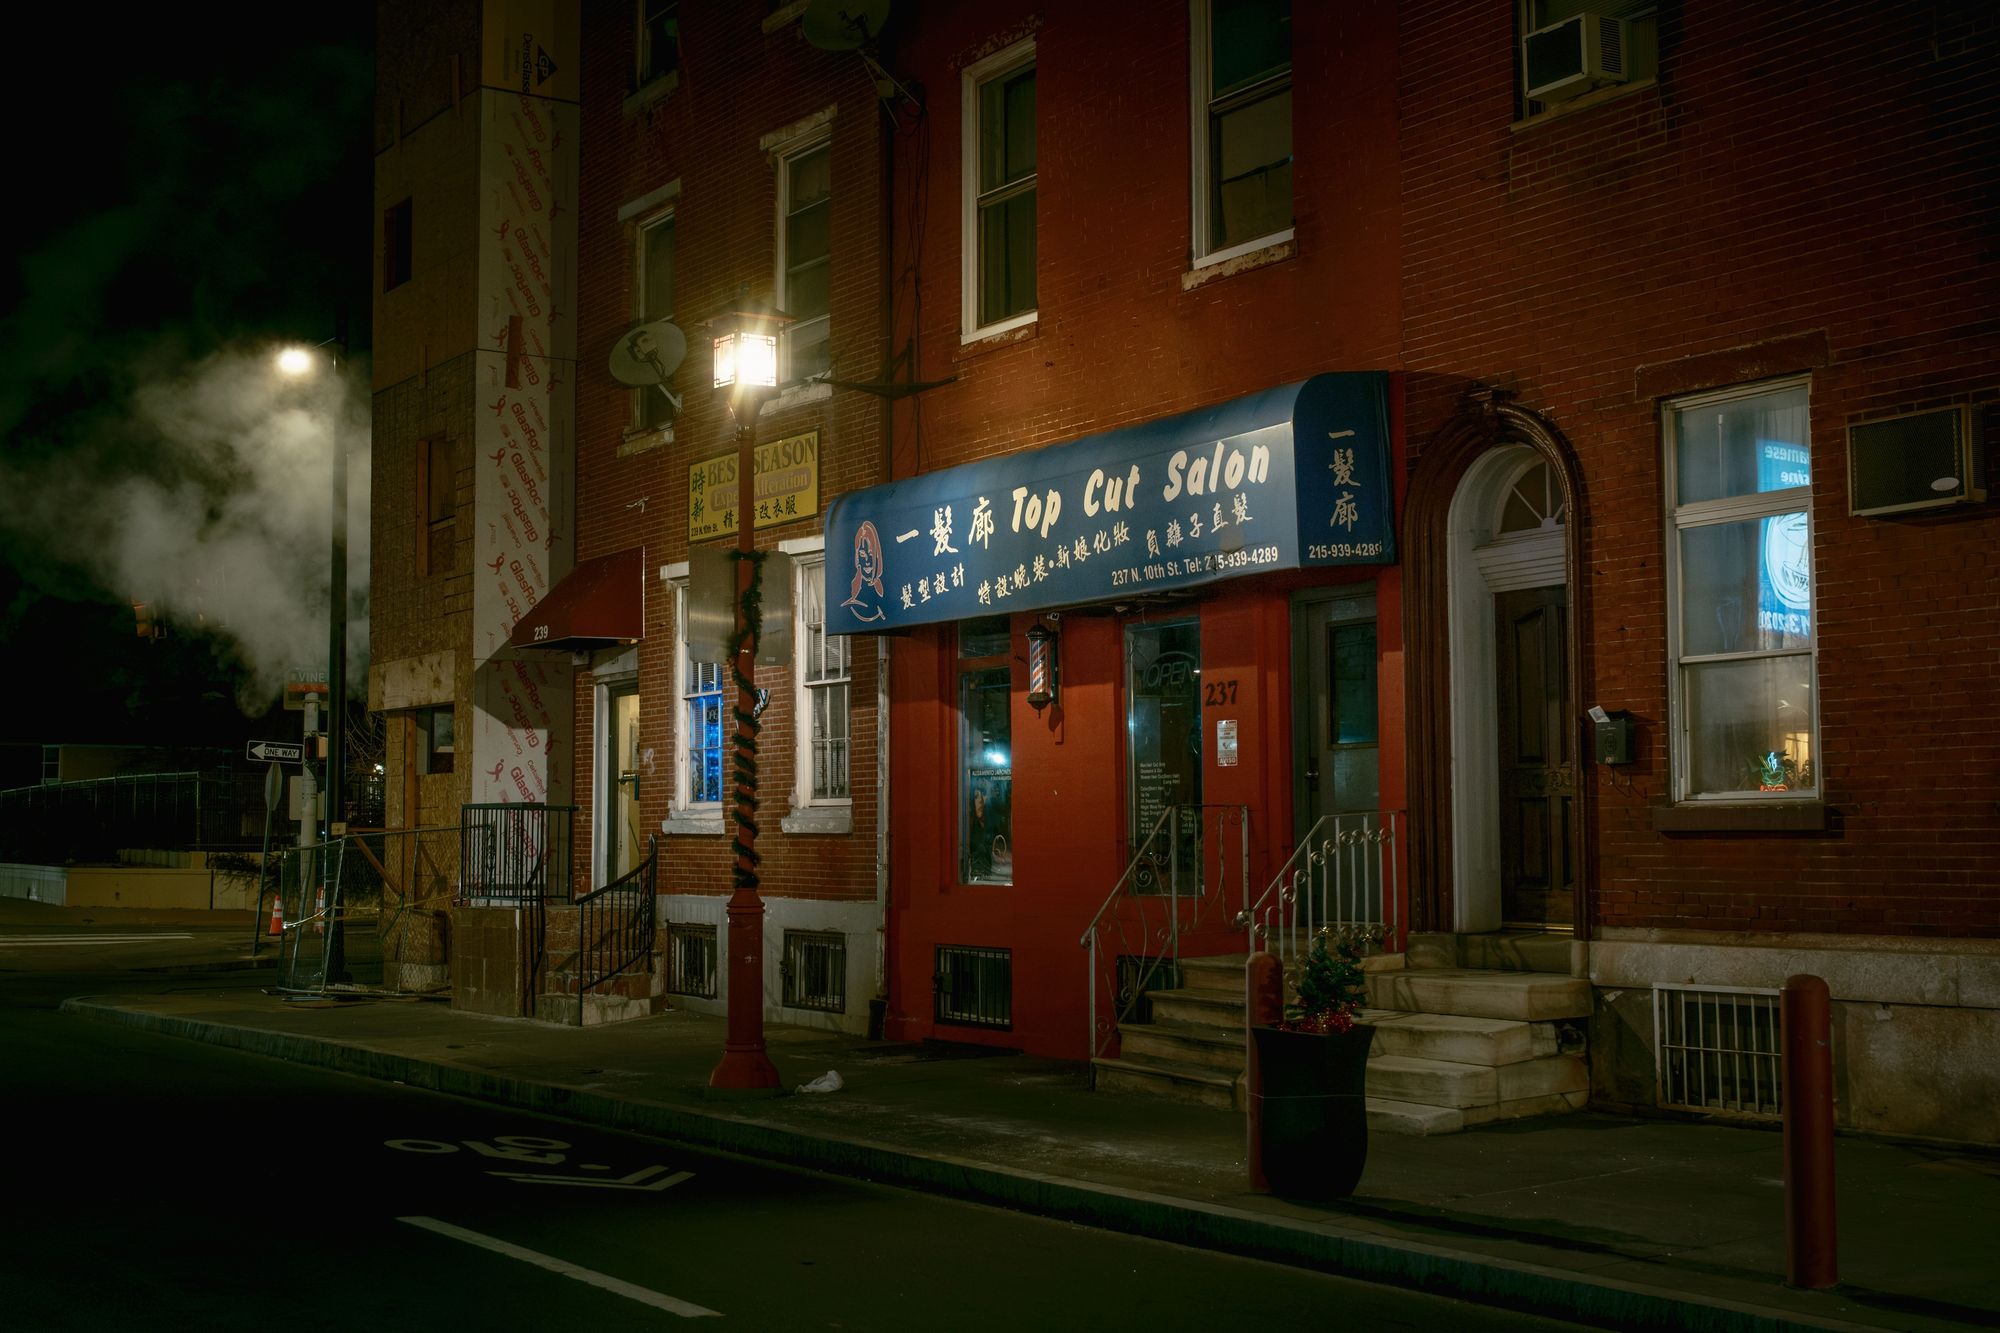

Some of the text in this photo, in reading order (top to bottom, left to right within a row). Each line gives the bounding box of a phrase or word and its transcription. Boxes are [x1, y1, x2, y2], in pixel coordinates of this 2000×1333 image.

[514, 227, 545, 281] GlasRoc
[510, 263, 541, 318] GlasRoc
[511, 452, 541, 506] GlasRoc
[708, 456, 739, 487] BES
[1012, 486, 1061, 539] Top
[1084, 464, 1140, 517] Cut
[1163, 441, 1270, 502] Salon
[508, 489, 538, 543] GlasRoc
[510, 559, 537, 606] GlasRo
[1112, 569, 1128, 586] 237
[1131, 567, 1142, 582] N.
[1143, 563, 1165, 580] 10th
[1167, 560, 1182, 577] St.
[1183, 557, 1202, 574] Tel:
[533, 624, 549, 641] 239
[298, 671, 326, 683] VINE
[1147, 661, 1194, 688] OPEN
[1205, 679, 1238, 706] 237
[509, 694, 540, 749] GlasRoc
[264, 747, 298, 757] ONE WAY
